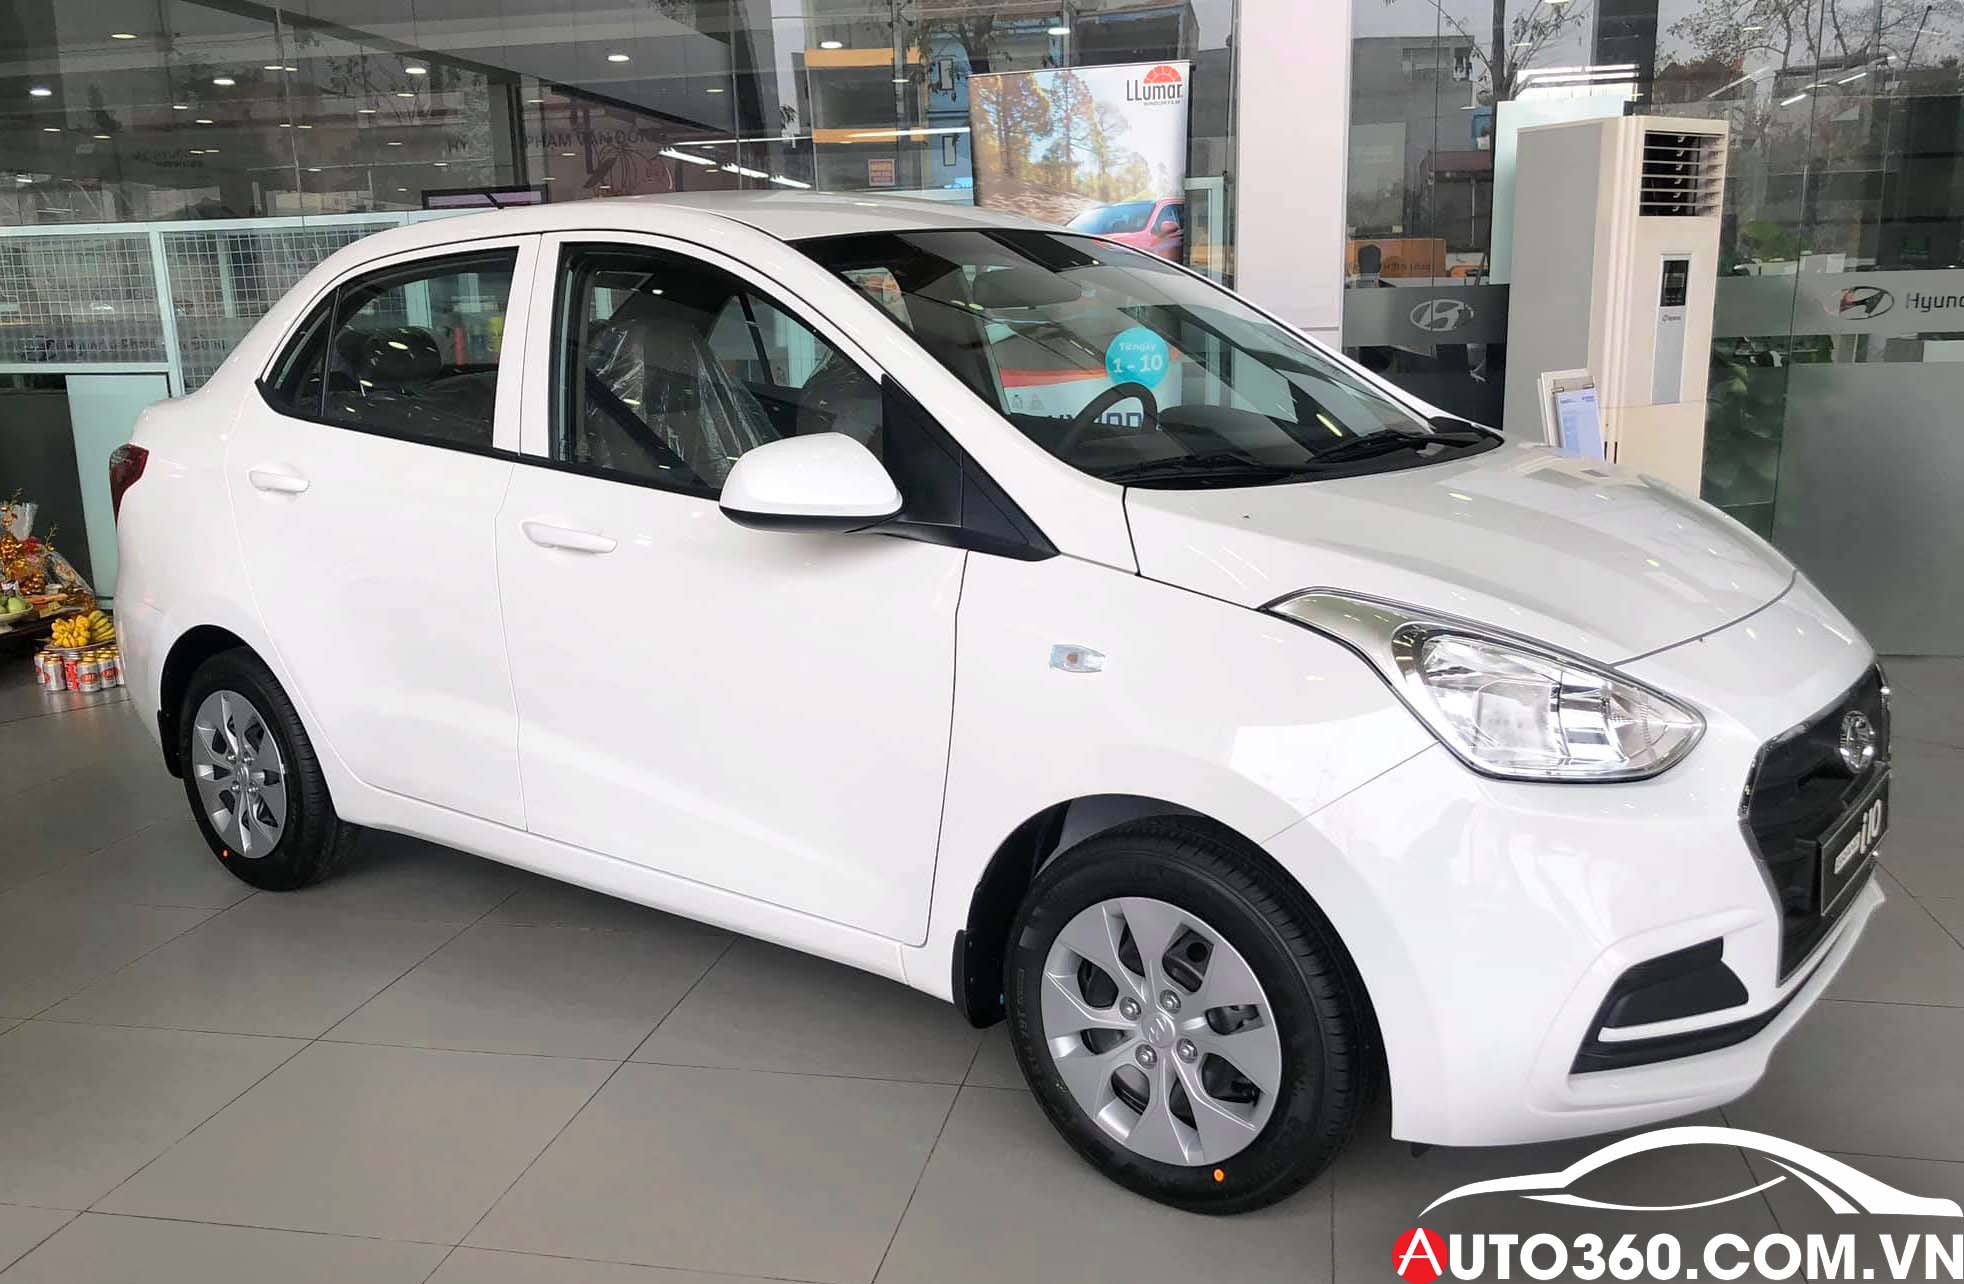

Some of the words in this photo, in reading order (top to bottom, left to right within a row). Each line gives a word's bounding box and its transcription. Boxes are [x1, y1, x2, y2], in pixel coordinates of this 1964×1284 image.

[1126, 79, 1184, 101] LLumar
[1140, 354, 1163, 373] 10
[1859, 798, 1883, 855] i10
